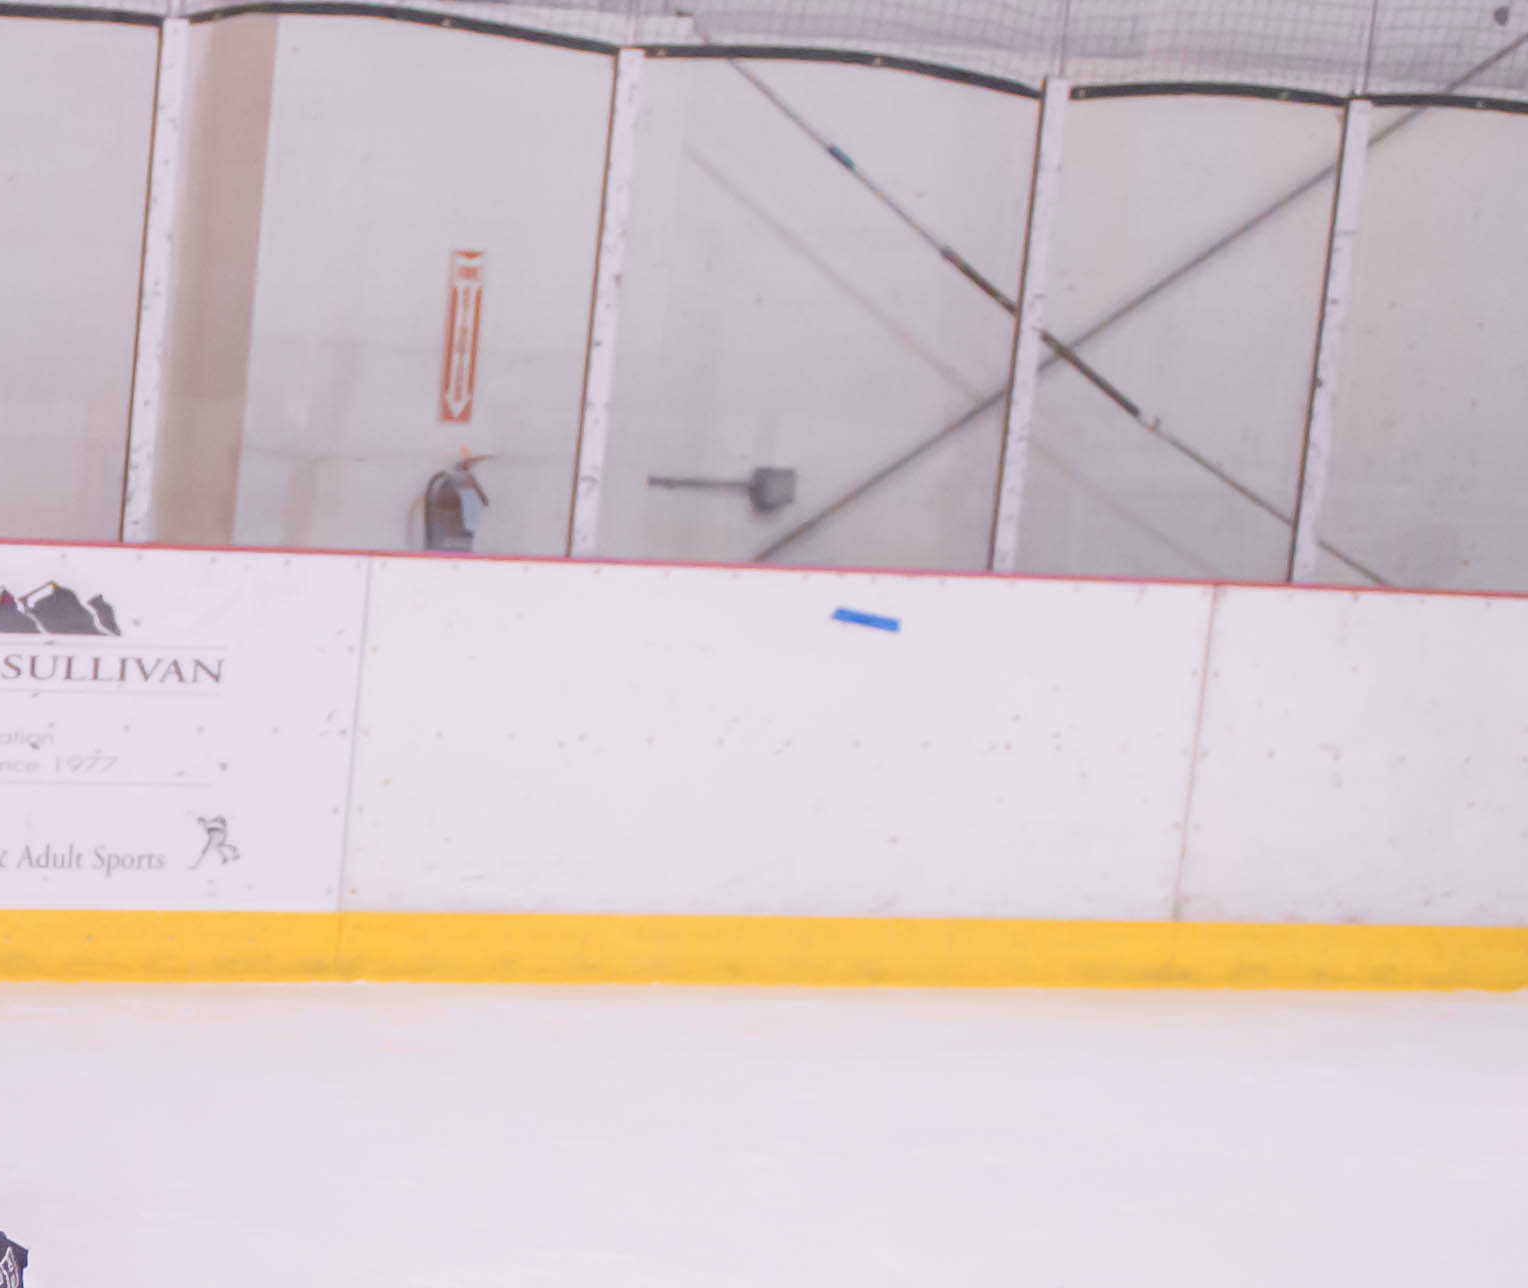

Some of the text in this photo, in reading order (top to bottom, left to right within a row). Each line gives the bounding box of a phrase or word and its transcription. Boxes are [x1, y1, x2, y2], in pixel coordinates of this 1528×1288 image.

[1, 653, 225, 684] SULLIVAN
[55, 755, 120, 774] 1977
[17, 844, 84, 870] Adult
[92, 845, 166, 878] Sports
